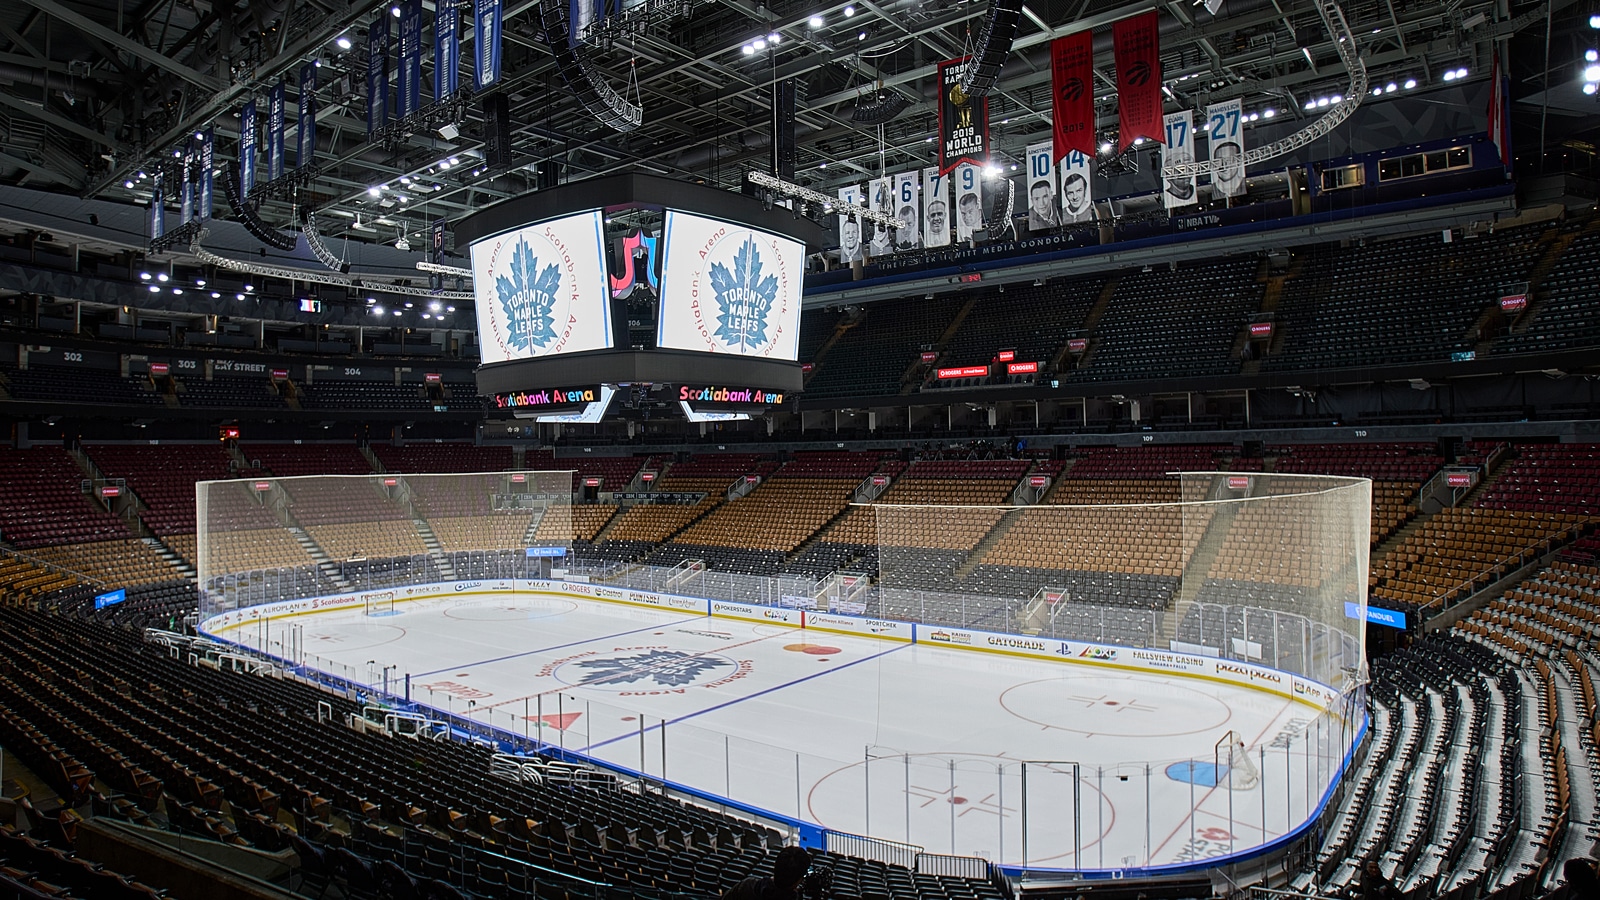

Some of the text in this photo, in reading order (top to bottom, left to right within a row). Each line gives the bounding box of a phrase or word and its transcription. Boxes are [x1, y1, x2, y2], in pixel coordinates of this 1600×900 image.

[953, 127, 974, 139] 2019
[1063, 122, 1084, 133] 2019
[1211, 110, 1240, 140] 27
[946, 135, 982, 151] WORLD
[1166, 121, 1187, 149] 17
[946, 145, 982, 158] CHAMPIONS
[1066, 150, 1084, 170] 14
[1032, 153, 1049, 178] 10
[930, 176, 940, 197] 7
[963, 168, 973, 190] 9
[902, 181, 911, 203] 6
[1186, 217, 1203, 228] NBA
[434, 232, 442, 249] 15
[698, 227, 726, 260] Arena
[983, 244, 1015, 254] MEDIA
[1021, 235, 1075, 249] GONDOLA
[488, 241, 501, 278] Arena
[545, 227, 579, 300] Scotiabank
[772, 240, 788, 314] Scotiabank
[556, 314, 577, 352] Arena
[764, 325, 783, 356] Arena
[64, 352, 82, 362] 302
[178, 360, 196, 368] 303
[234, 363, 266, 373] STREET
[496, 389, 594, 408] Scotiabank Arena
[680, 385, 783, 405] Scotiabank Arena
[568, 584, 590, 593] ROGERS
[602, 589, 623, 598] Castrol
[321, 596, 356, 606] Scotiabank
[720, 605, 752, 613] POKERSTARS
[865, 620, 897, 628] SPORTCHEK
[1367, 611, 1395, 623] FANDUEL
[988, 636, 1045, 651] GATORADE
[1133, 651, 1204, 666] FALLSVIEW CASINO
[1216, 663, 1281, 684] pizza pizza
[619, 688, 685, 697] Arena
